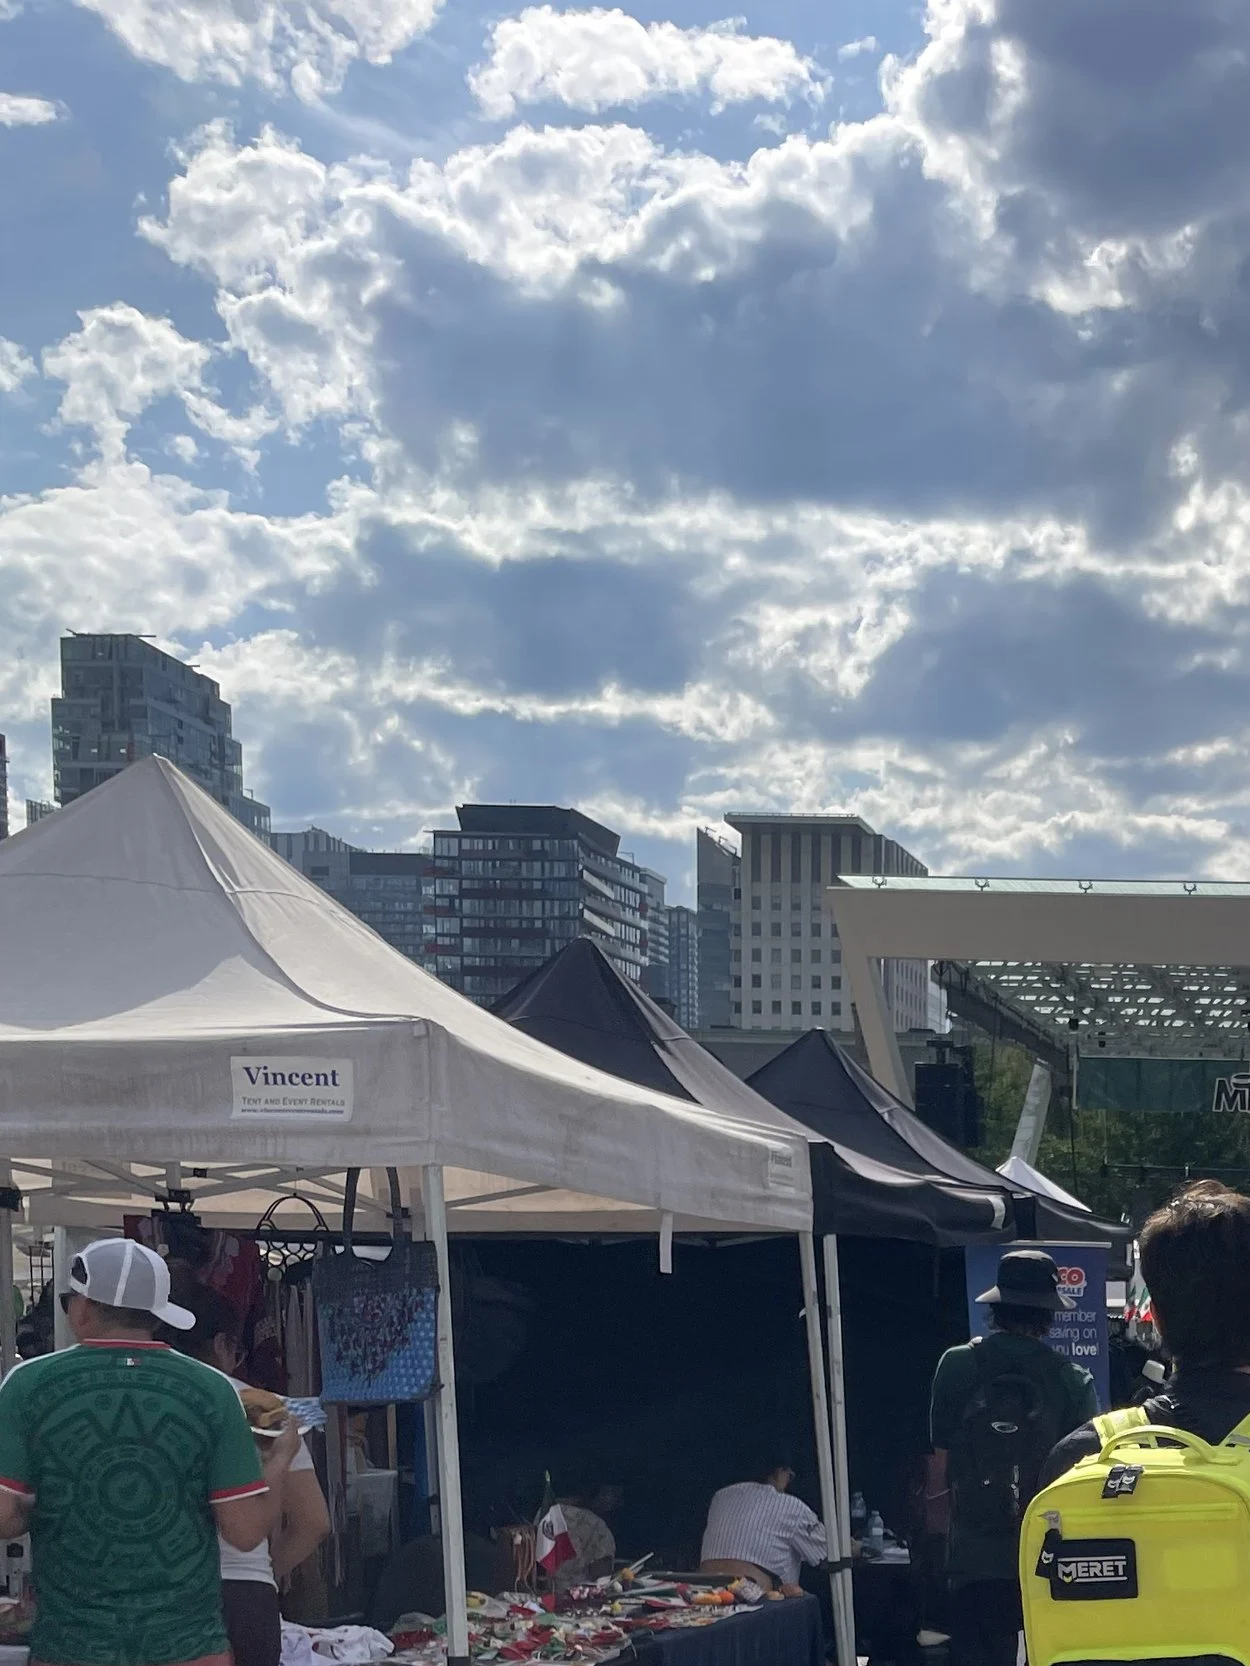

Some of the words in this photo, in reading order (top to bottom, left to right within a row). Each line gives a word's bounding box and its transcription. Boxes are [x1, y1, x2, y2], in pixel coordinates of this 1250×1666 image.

[242, 1065, 340, 1087] Vincent
[1054, 1309, 1097, 1322] member
[1049, 1327, 1080, 1342] saving
[1082, 1329, 1098, 1339] on
[1057, 1560, 1127, 1583] MERET
